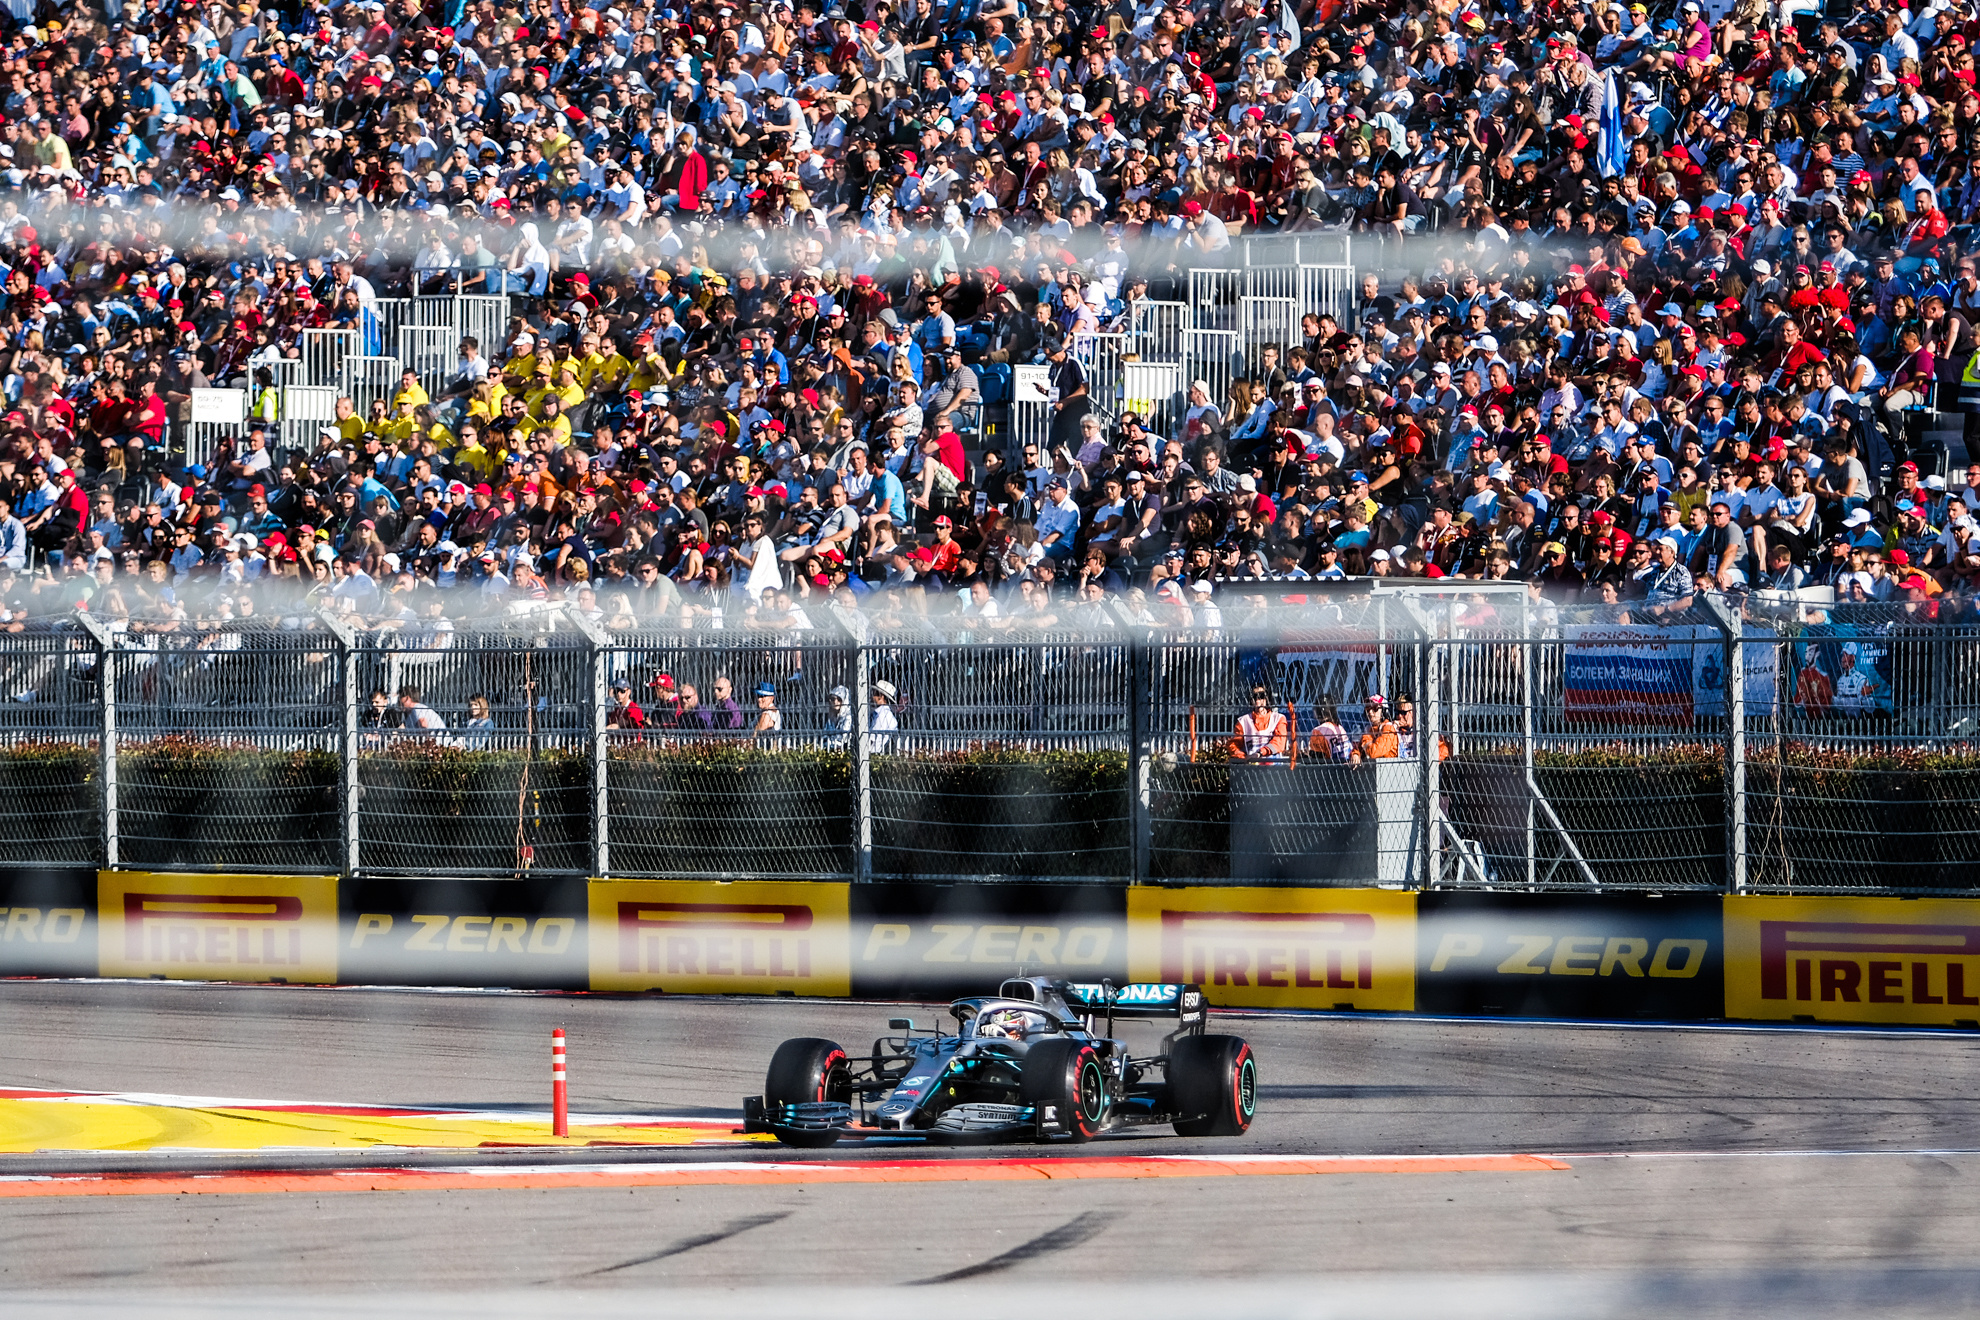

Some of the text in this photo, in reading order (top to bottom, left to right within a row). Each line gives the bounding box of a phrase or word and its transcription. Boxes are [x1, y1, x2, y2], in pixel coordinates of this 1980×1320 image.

[1570, 665, 1616, 680] БОЛЕЕМ
[0, 906, 85, 943] RO
[124, 892, 303, 965] PIRELLI
[350, 913, 575, 955] P ZERO
[618, 901, 813, 978] PIRELLI
[863, 923, 1113, 965] P ZERO
[1160, 909, 1375, 989] PIRELLI
[1430, 933, 1708, 978] P ZERO
[1760, 920, 1980, 1006] PIRELL
[1072, 983, 1179, 1002] ETONAS
[976, 1104, 1018, 1112] PETRONAS
